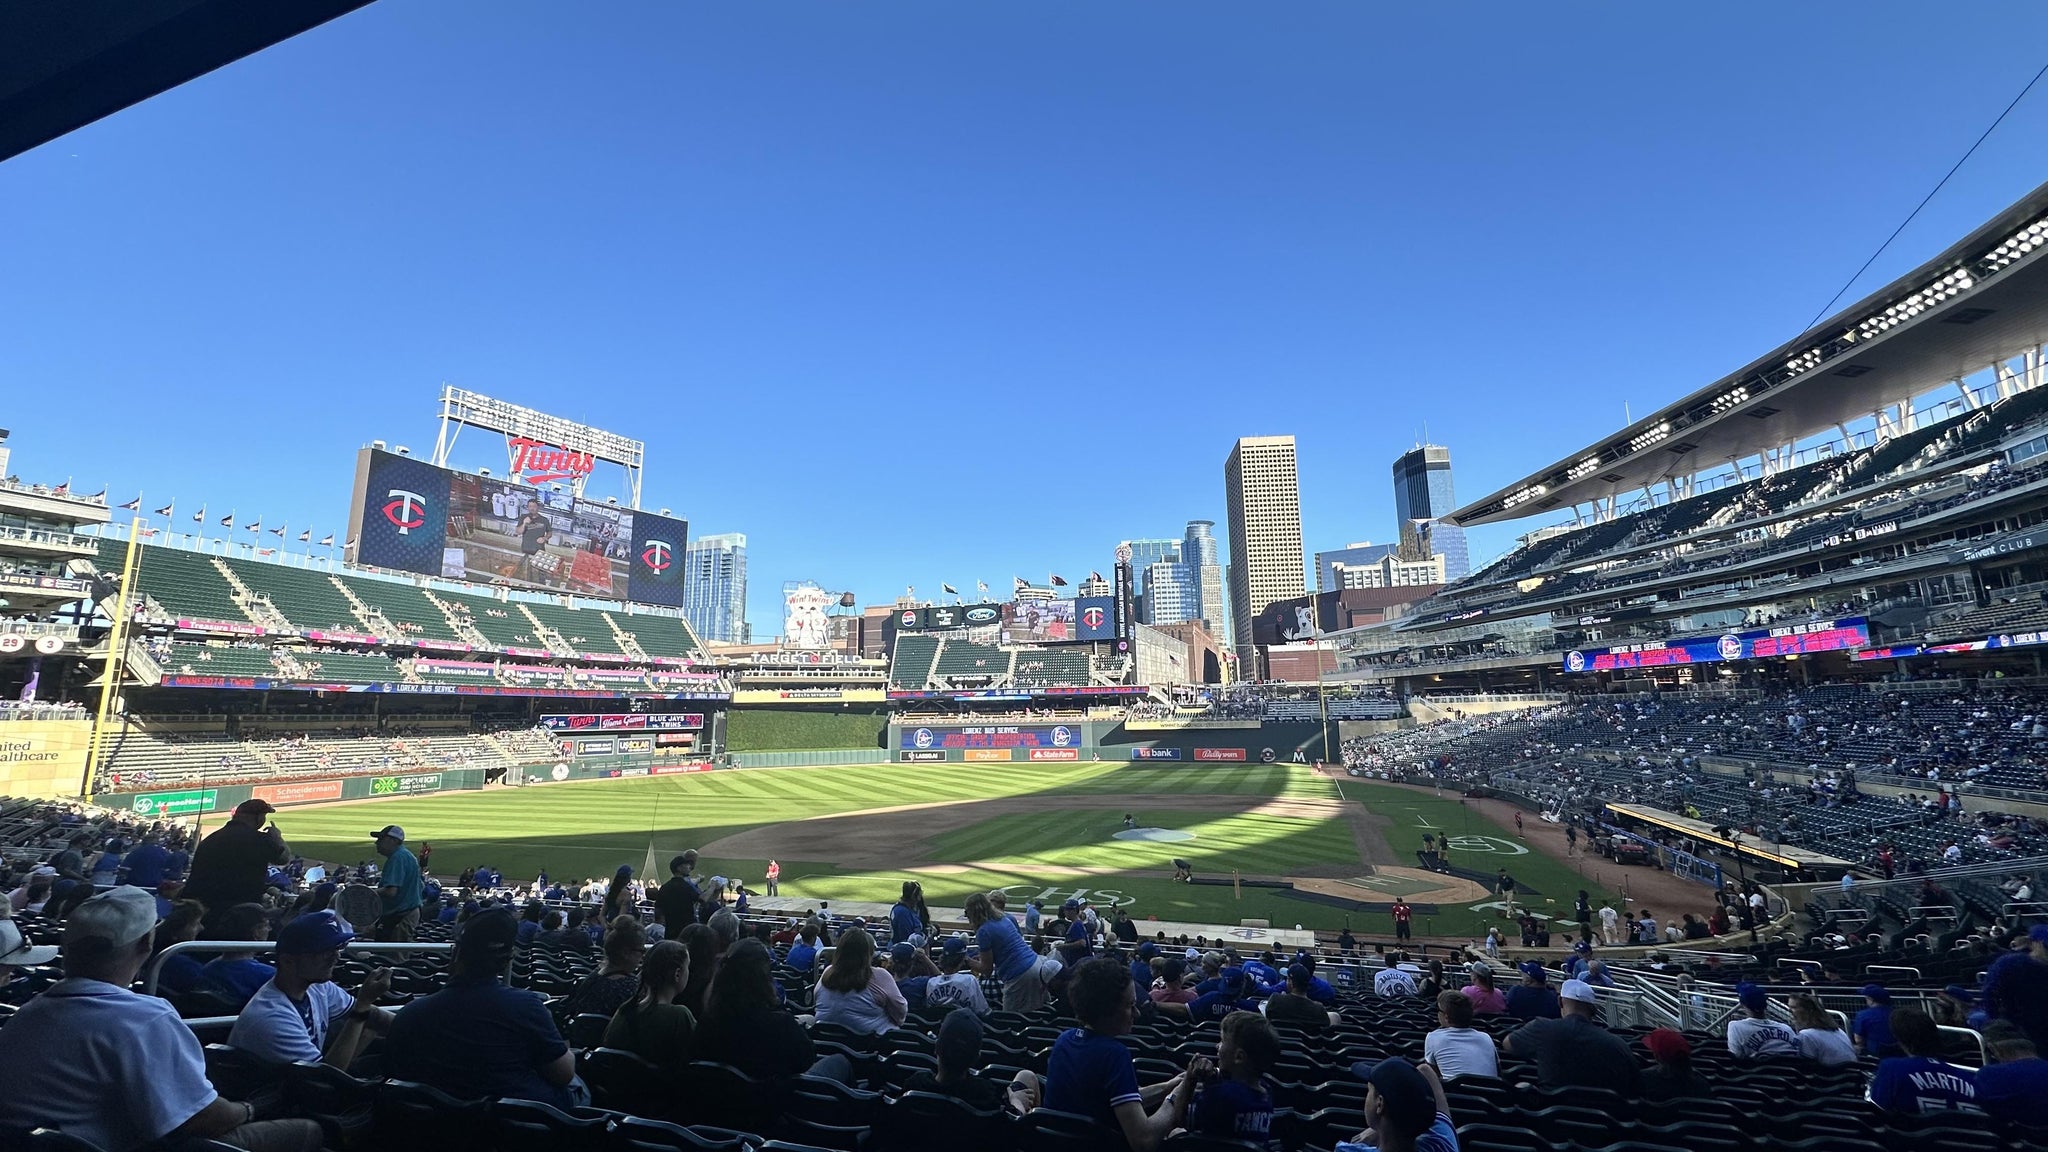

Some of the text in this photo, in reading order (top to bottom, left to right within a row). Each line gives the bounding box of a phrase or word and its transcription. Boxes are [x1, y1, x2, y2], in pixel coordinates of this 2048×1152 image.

[509, 437, 594, 481] Twins
[2000, 538, 2032, 552] CLUB
[973, 611, 989, 619] Ford
[190, 621, 256, 634] Treasure Island
[1769, 621, 1835, 638] LORENZ BUS SERVICE
[2, 638, 18, 647] 29
[1610, 642, 1666, 654] LORENZ BUS SERVICE
[751, 654, 862, 664] TARGET FIELD
[433, 667, 488, 676] Treasure Island
[568, 716, 596, 729] Twins
[602, 716, 644, 729] Home Games
[1152, 748, 1172, 757] bank
[1202, 750, 1222, 759] Bally
[276, 784, 337, 796] Schneiderman's
[1746, 1028, 1789, 1051] GUERRERO
[1909, 1072, 1974, 1098] MARTIN
